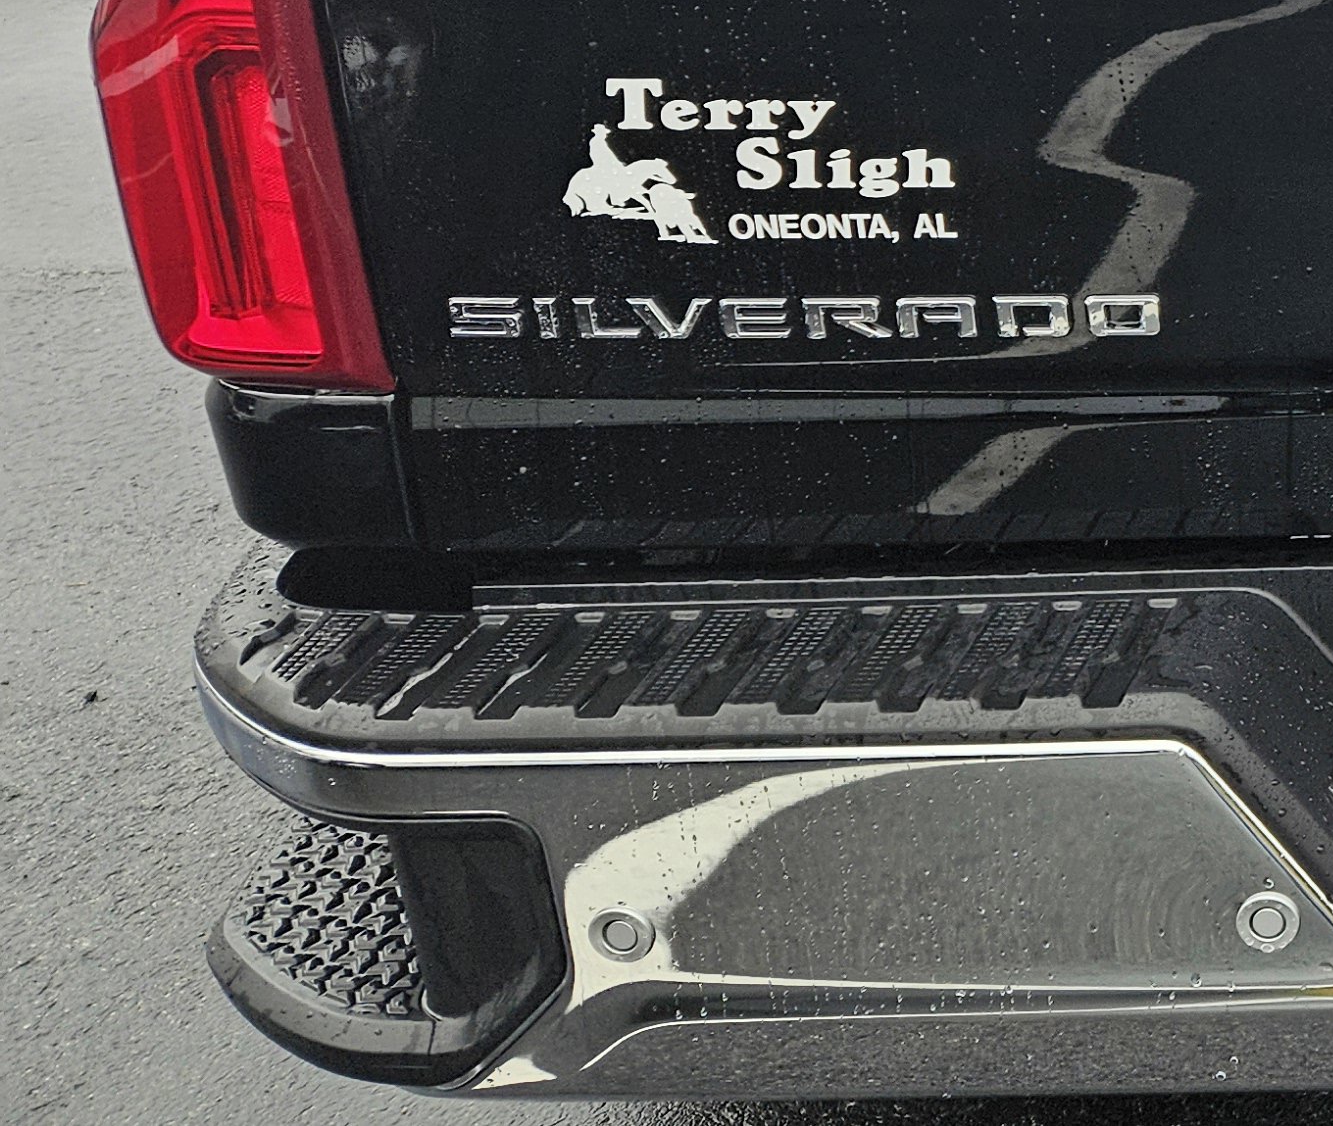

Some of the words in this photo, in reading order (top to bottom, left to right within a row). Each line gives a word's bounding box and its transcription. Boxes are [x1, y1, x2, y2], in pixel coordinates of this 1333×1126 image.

[605, 78, 836, 139] Terry
[736, 136, 955, 198] Sligh
[728, 213, 900, 243] ONEONTA,
[914, 213, 958, 240] AL
[448, 294, 1162, 339] SILVERADO
